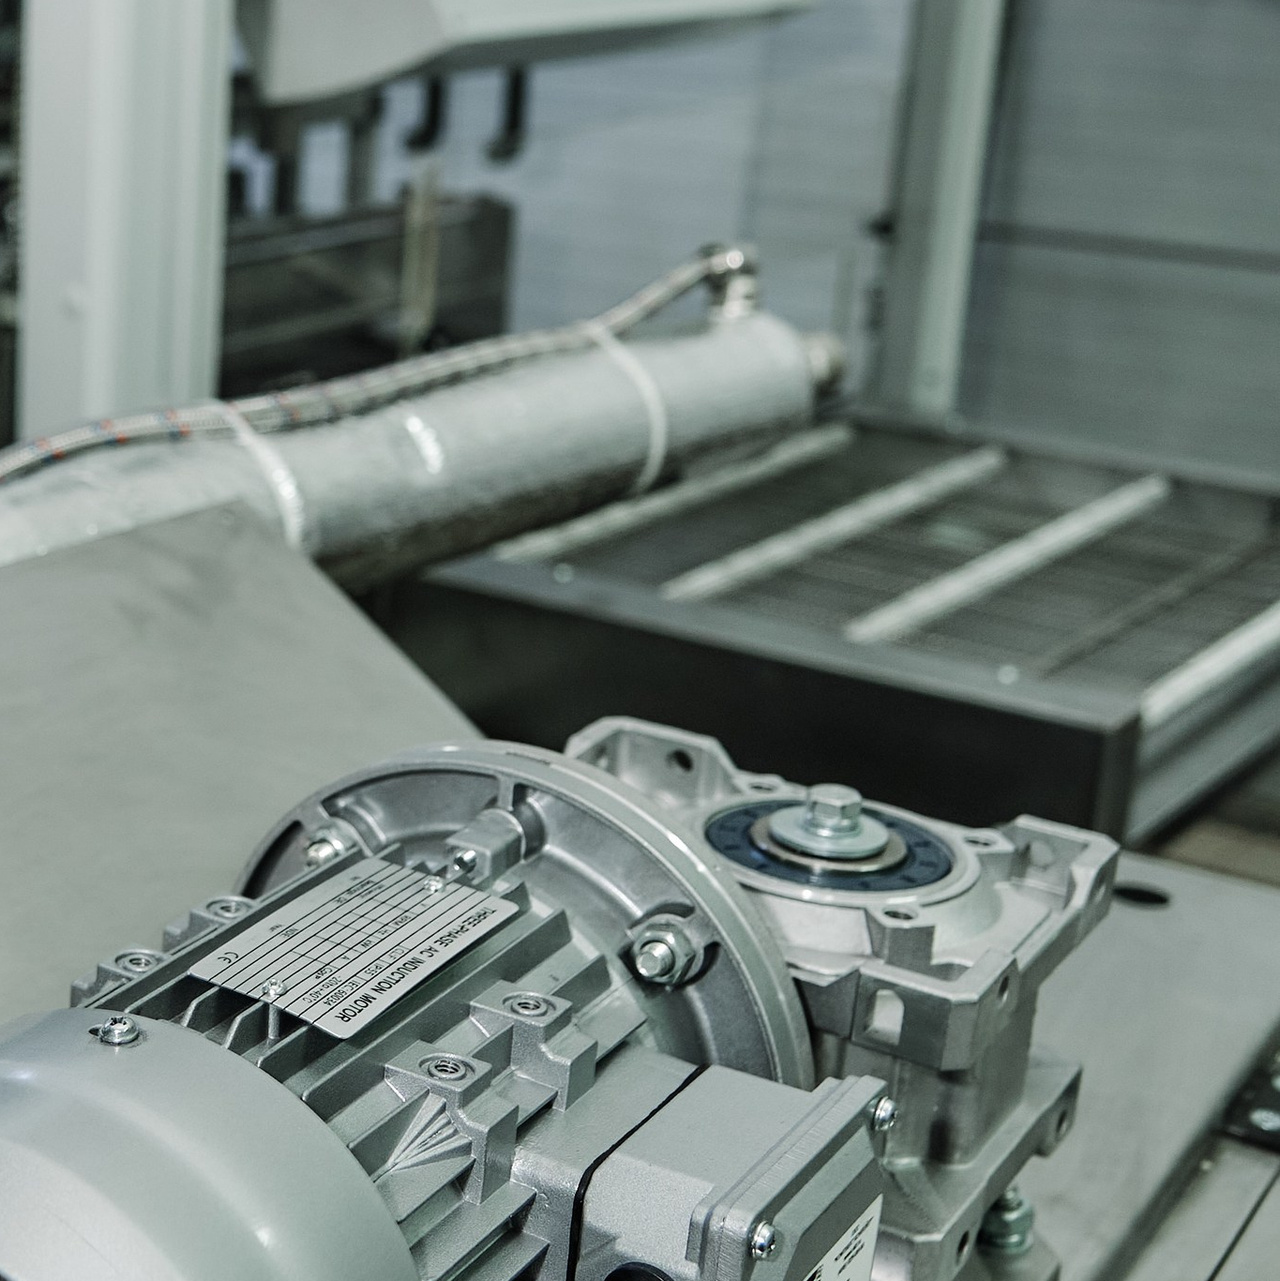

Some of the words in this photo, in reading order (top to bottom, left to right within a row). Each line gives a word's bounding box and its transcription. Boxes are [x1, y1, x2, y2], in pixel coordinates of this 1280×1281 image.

[432, 905, 497, 948] THREE-PHASE
[417, 944, 442, 958] AC
[361, 962, 385, 976] IP55
[369, 956, 427, 994] INDUCTION
[331, 992, 379, 1023] MOTOR
